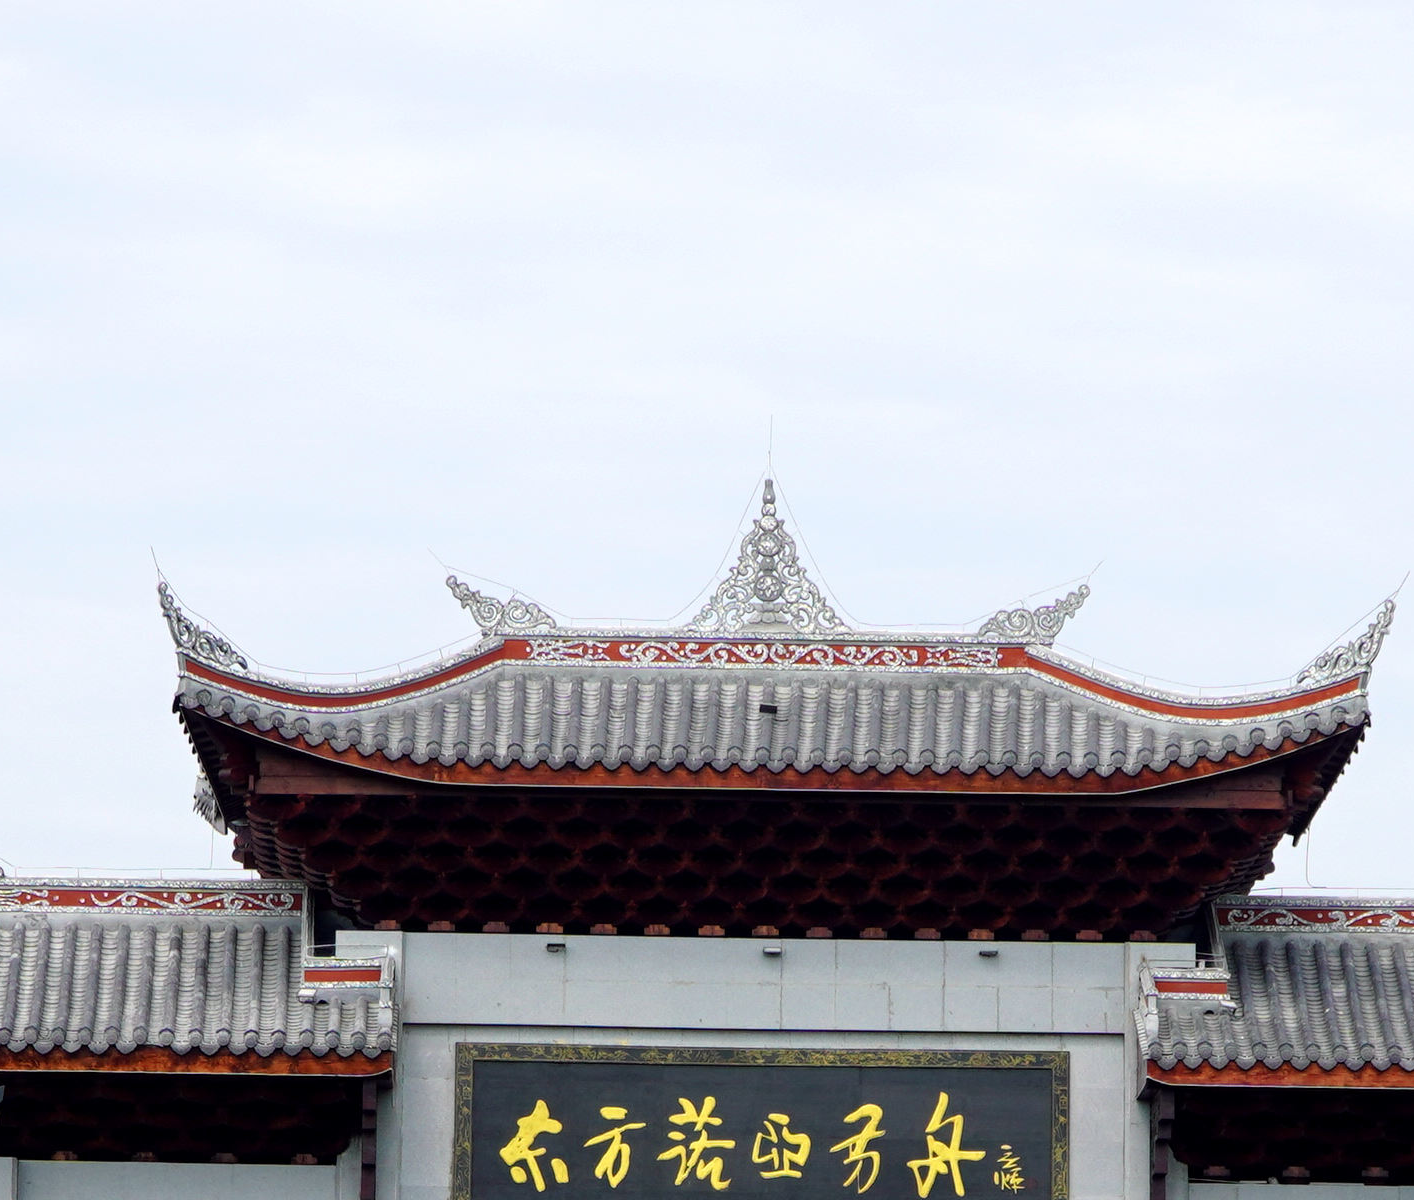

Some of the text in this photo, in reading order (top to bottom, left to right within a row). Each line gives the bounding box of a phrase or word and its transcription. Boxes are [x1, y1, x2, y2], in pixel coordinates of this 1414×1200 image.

[499, 1092, 986, 1198] 东方诺亚方舟
